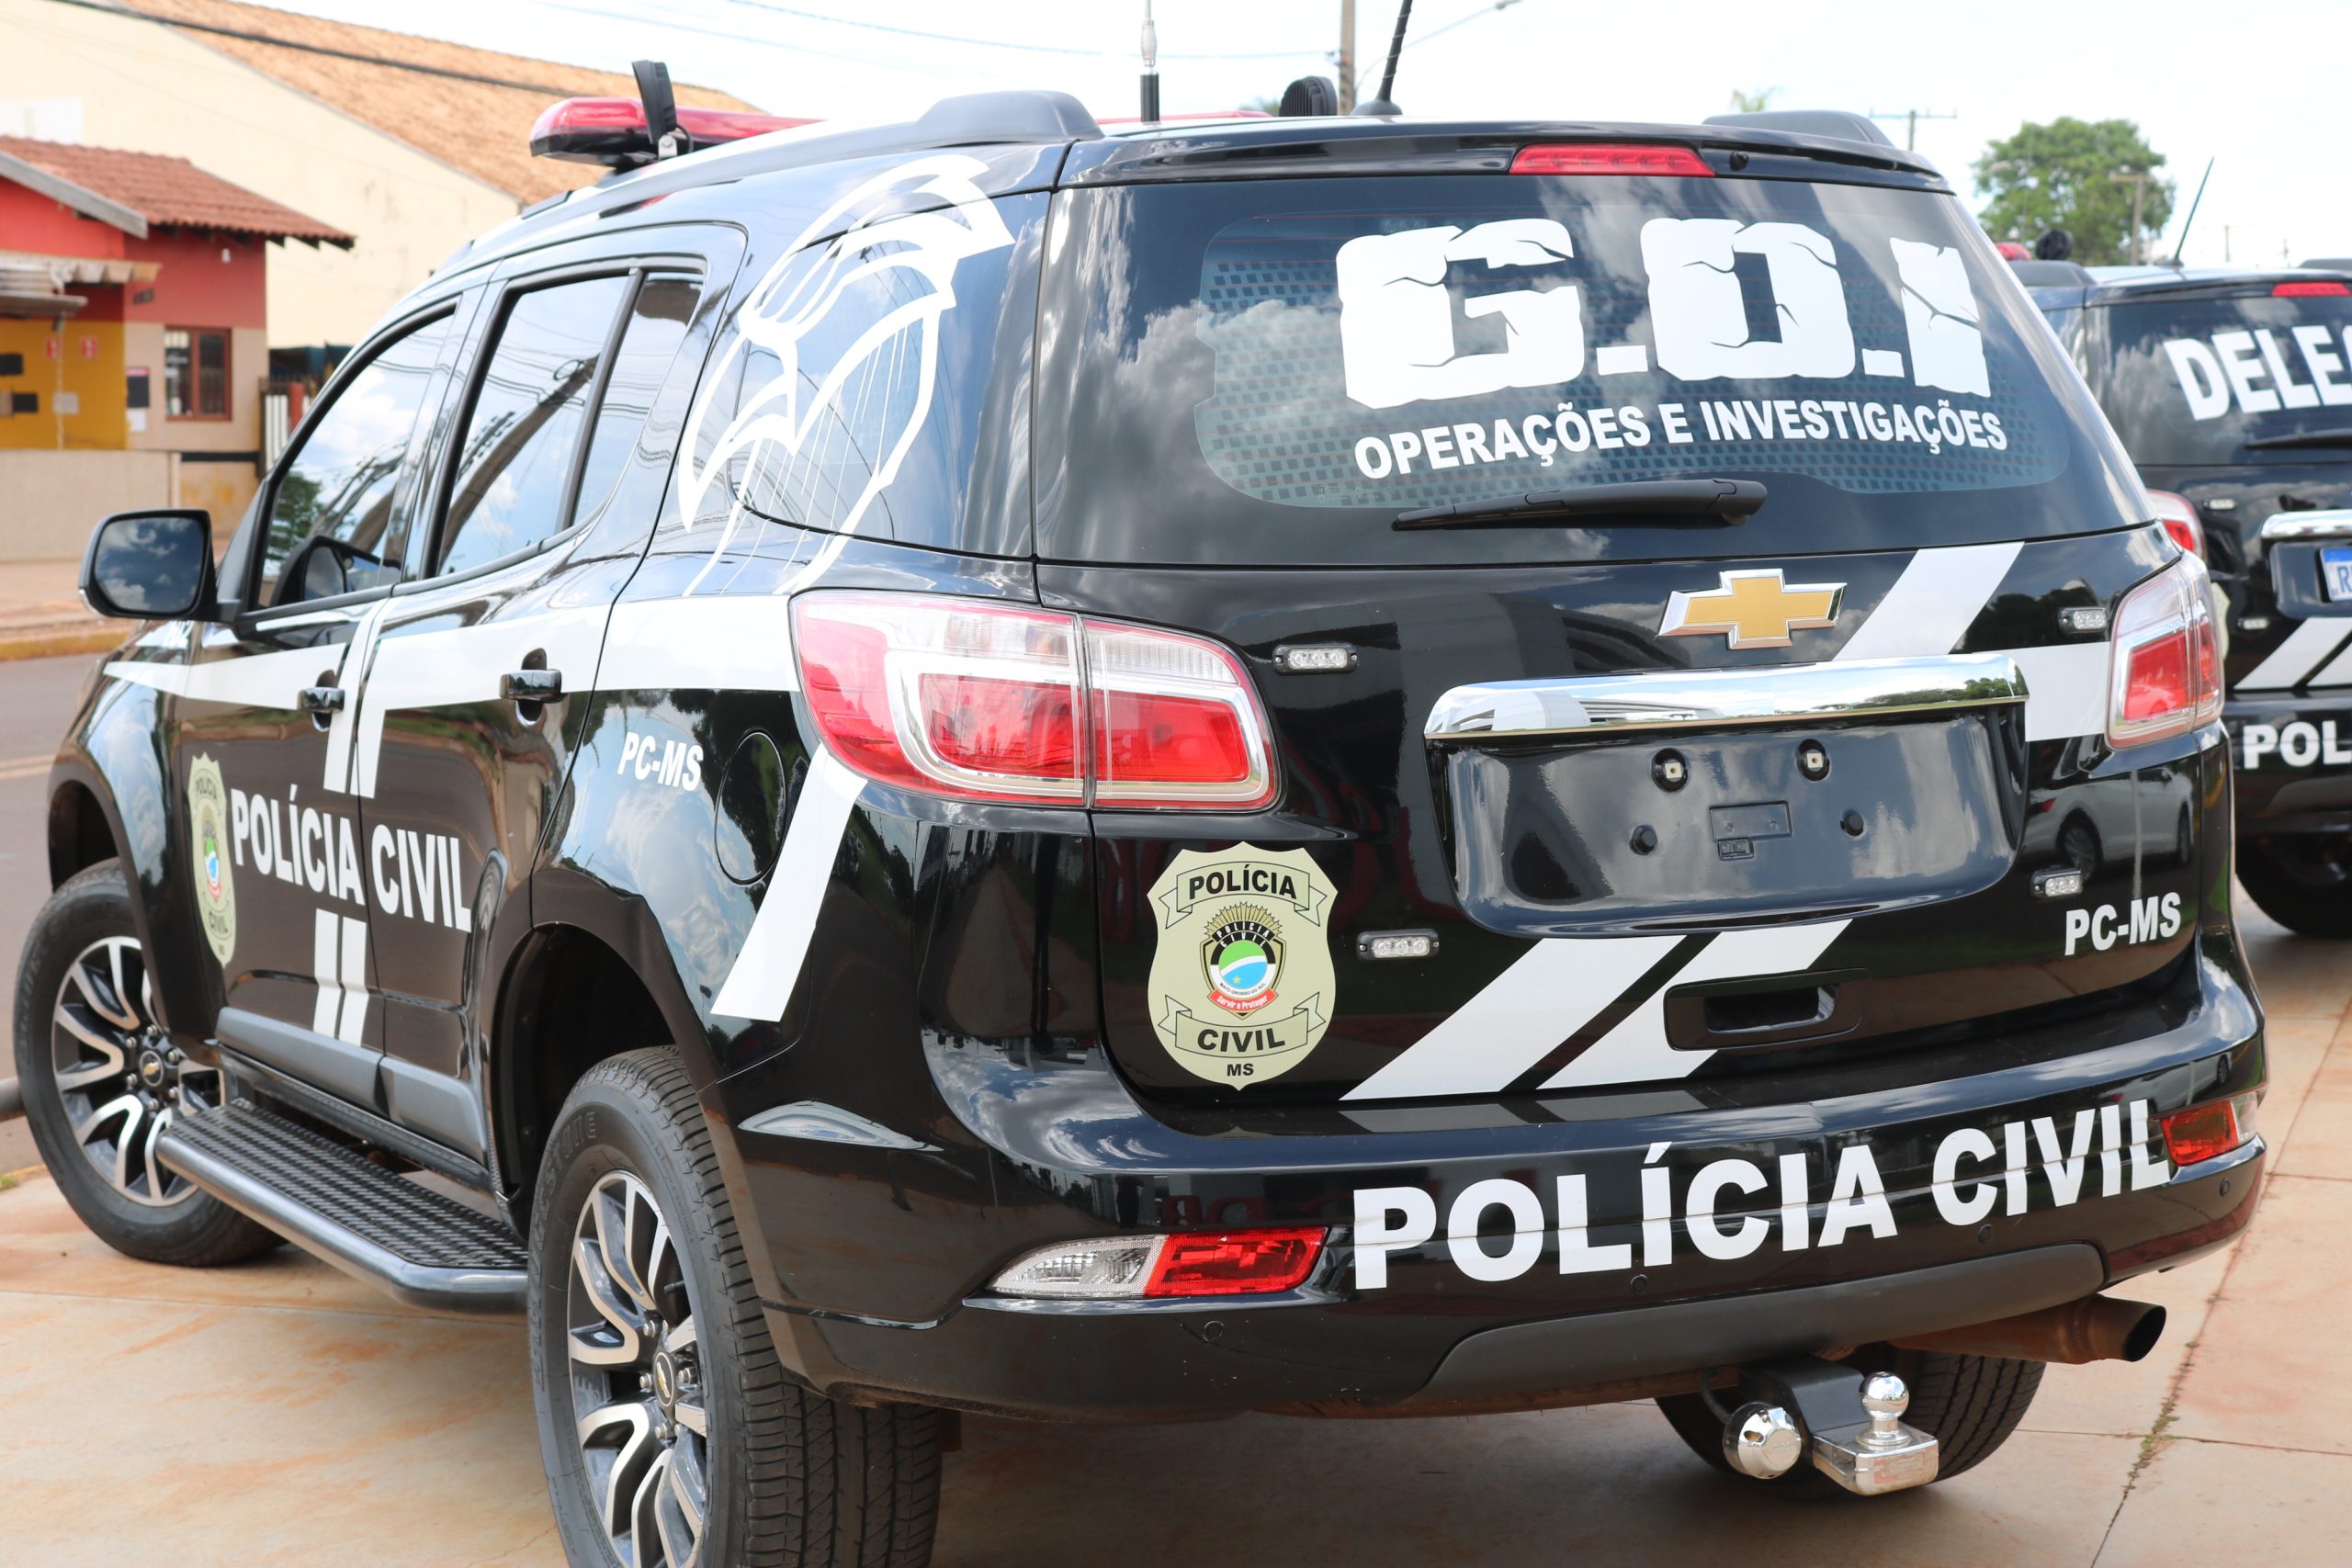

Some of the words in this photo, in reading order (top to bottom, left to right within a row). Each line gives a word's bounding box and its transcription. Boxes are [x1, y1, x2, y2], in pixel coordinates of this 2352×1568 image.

[1336, 218, 1991, 409] G.O.I
[2163, 325, 2352, 422] DELE
[1354, 402, 1651, 479] OPERAÇÕES
[1666, 404, 1693, 444] E
[1701, 399, 2007, 455] INVESTIGAÇÕES
[617, 732, 703, 792] PC-MS
[231, 784, 366, 907] POLÍCIA
[371, 824, 471, 933] CIVIL
[1189, 864, 1297, 900] POLÍCIA
[209, 909, 229, 934] CIVIL
[1220, 931, 1266, 948] CIVIL
[2064, 891, 2181, 956] PC-MS
[1197, 1028, 1286, 1053] CIVIL
[1227, 1063, 1254, 1077] MS
[1354, 1142, 1898, 1290] POLÍCIA
[1931, 1099, 2171, 1227] CIVIL
